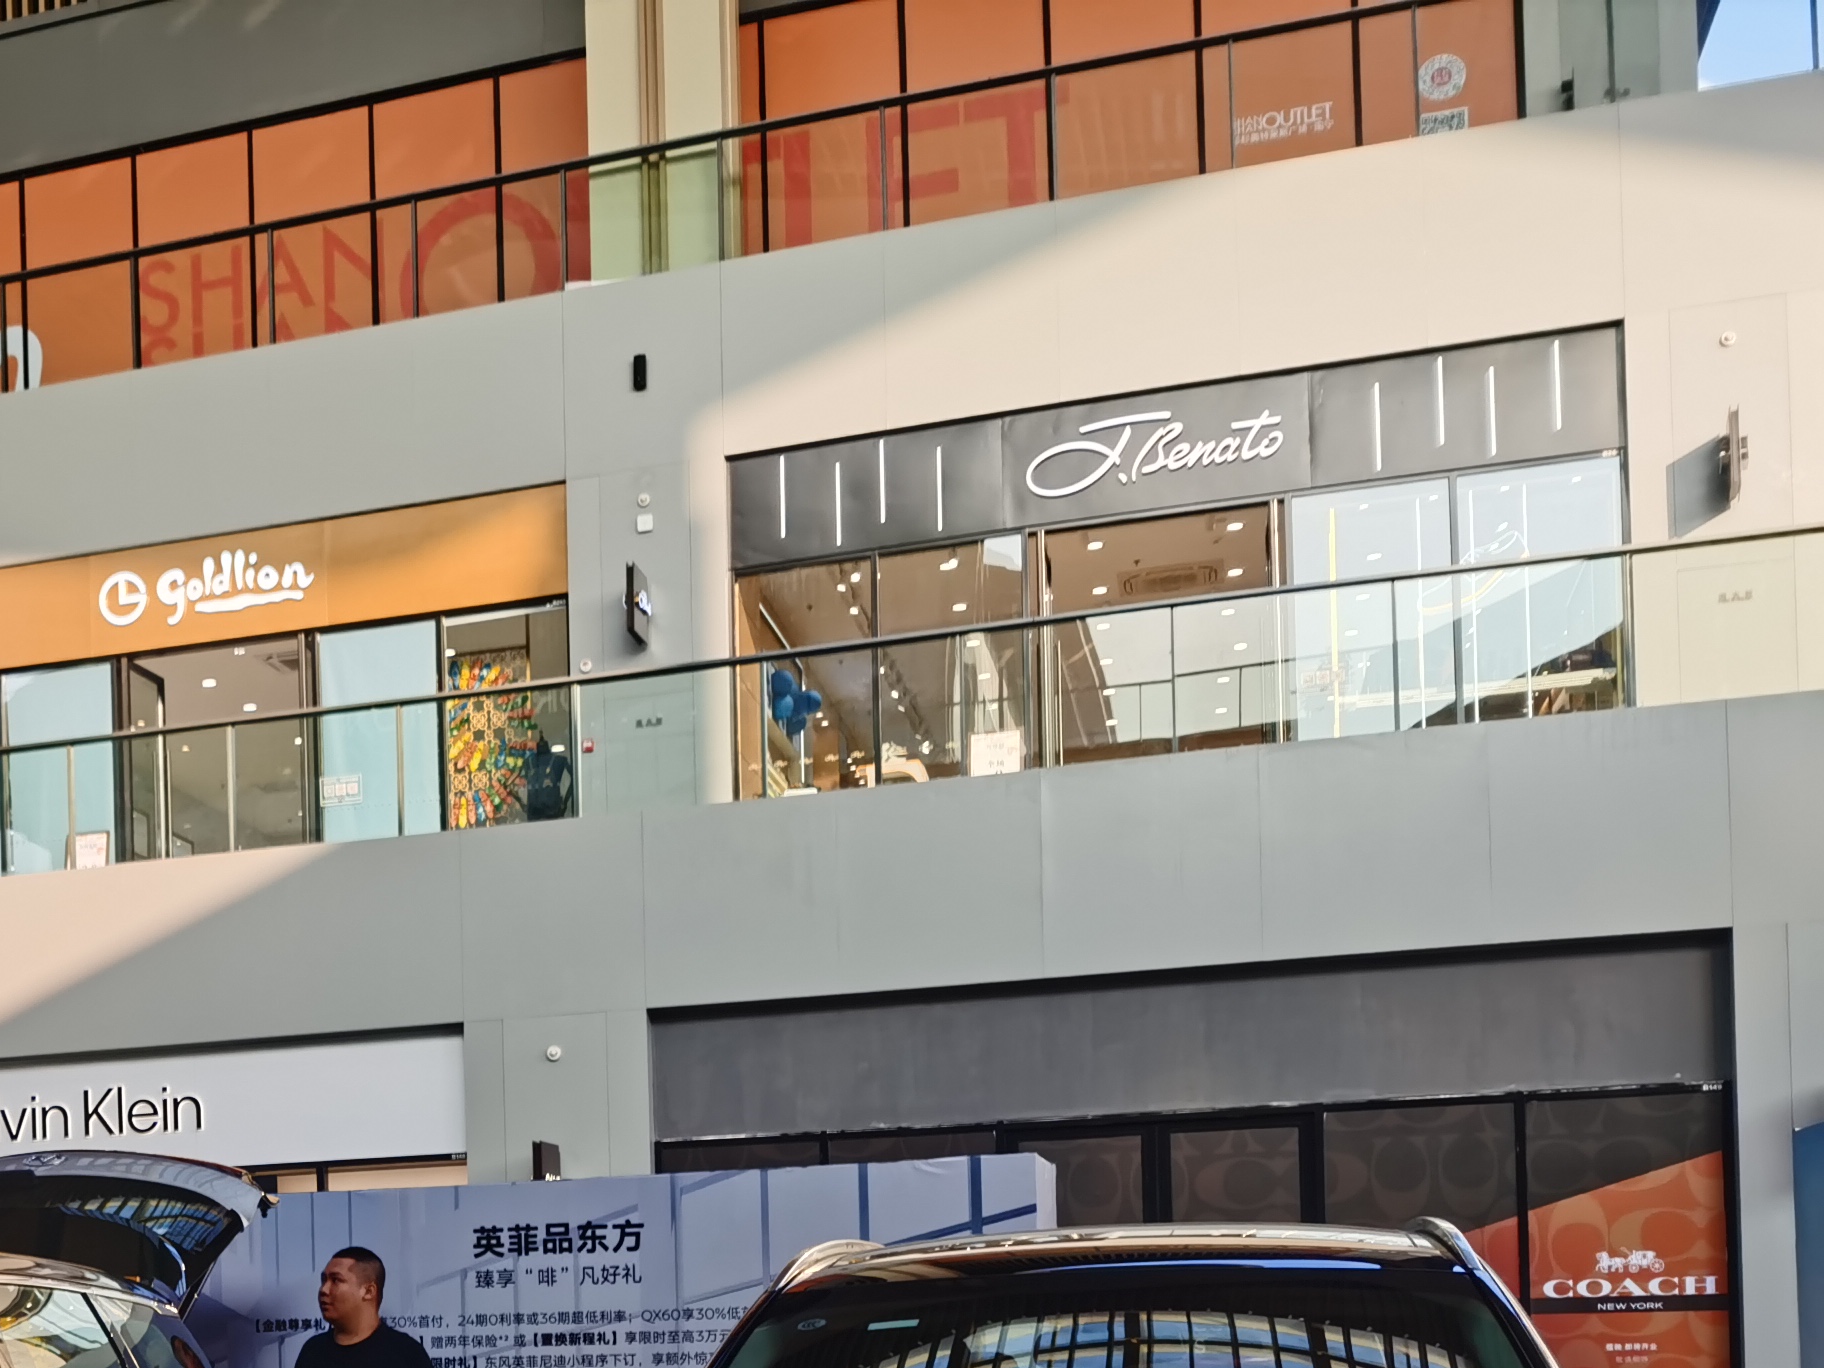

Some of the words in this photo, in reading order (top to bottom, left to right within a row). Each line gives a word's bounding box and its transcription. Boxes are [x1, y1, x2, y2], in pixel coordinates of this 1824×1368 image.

[82, 1085, 205, 1137] Klein
[472, 1219, 645, 1258] 英菲品东方
[1542, 1275, 1720, 1298] COACH
[1597, 1302, 1628, 1311] NEW
[1630, 1301, 1664, 1310] YORK
